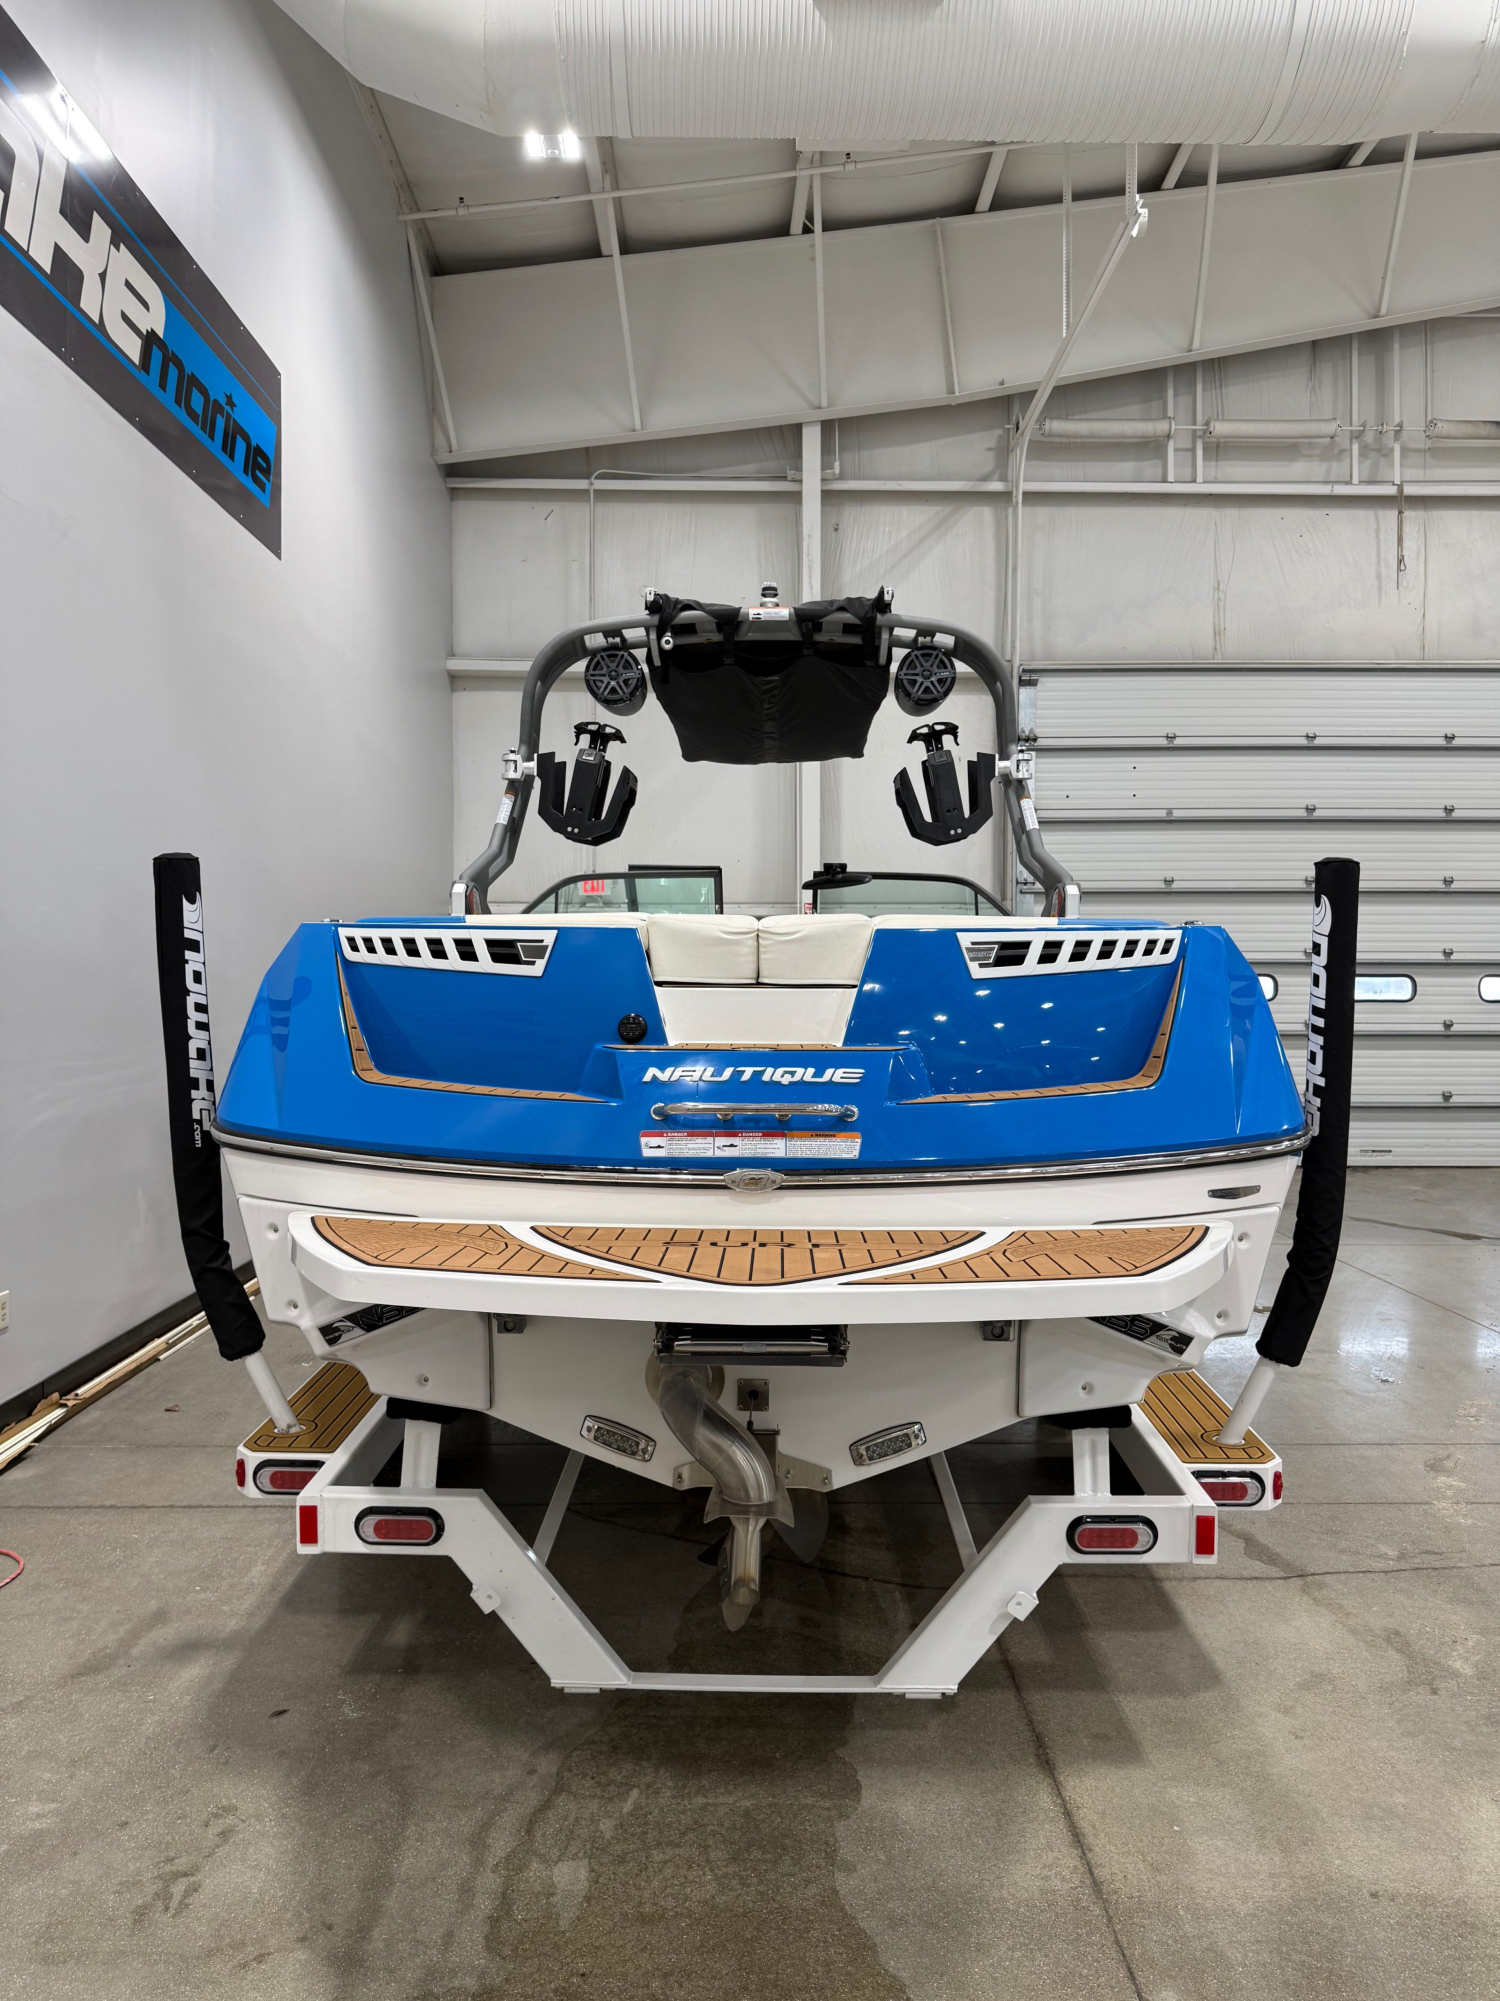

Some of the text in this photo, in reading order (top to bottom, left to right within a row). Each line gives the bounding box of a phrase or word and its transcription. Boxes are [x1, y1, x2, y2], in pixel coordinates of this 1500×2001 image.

[141, 327, 272, 494] marine
[582, 880, 605, 893] EXIT
[642, 1066, 865, 1085] NAUTIQUE
